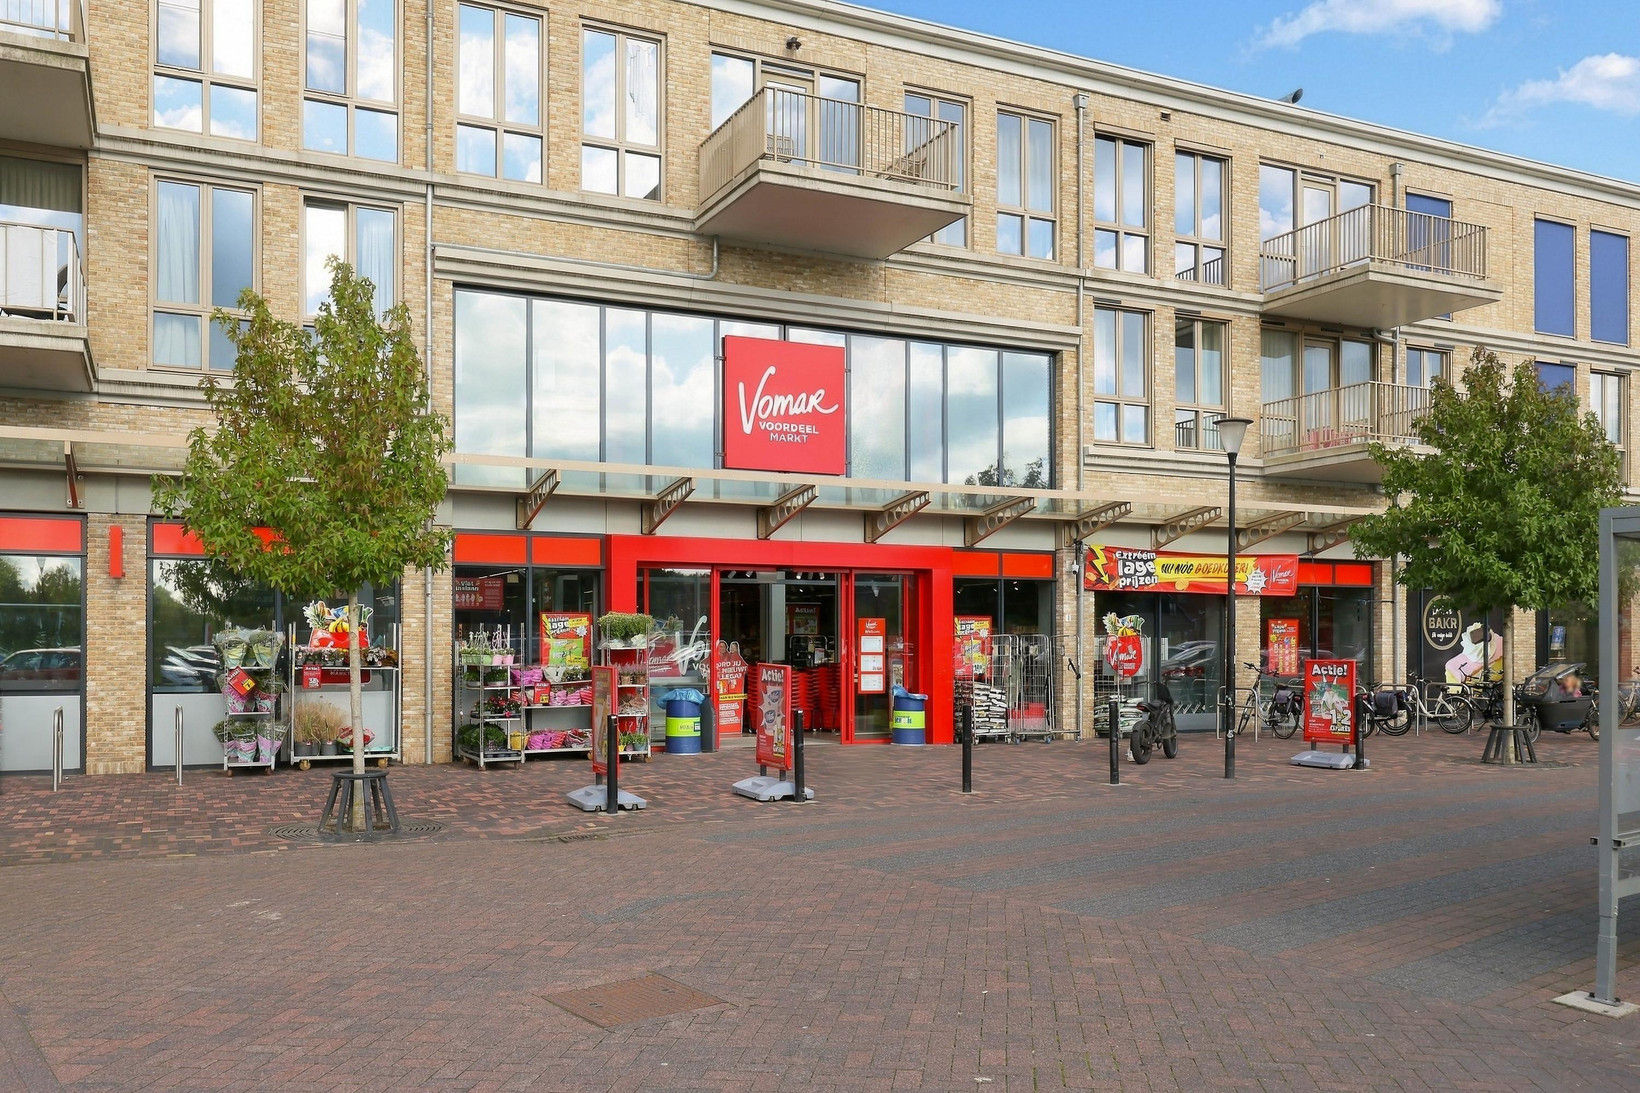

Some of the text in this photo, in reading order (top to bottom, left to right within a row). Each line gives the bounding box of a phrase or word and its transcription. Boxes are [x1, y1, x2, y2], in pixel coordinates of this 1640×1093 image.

[759, 421, 819, 434] VOORDEEL
[769, 432, 808, 443] MARKT
[1118, 560, 1156, 576] lage
[1119, 575, 1158, 588] prijzen
[1428, 617, 1457, 629] BAKR
[761, 668, 784, 683] Actie!
[1312, 664, 1348, 676] Actie!
